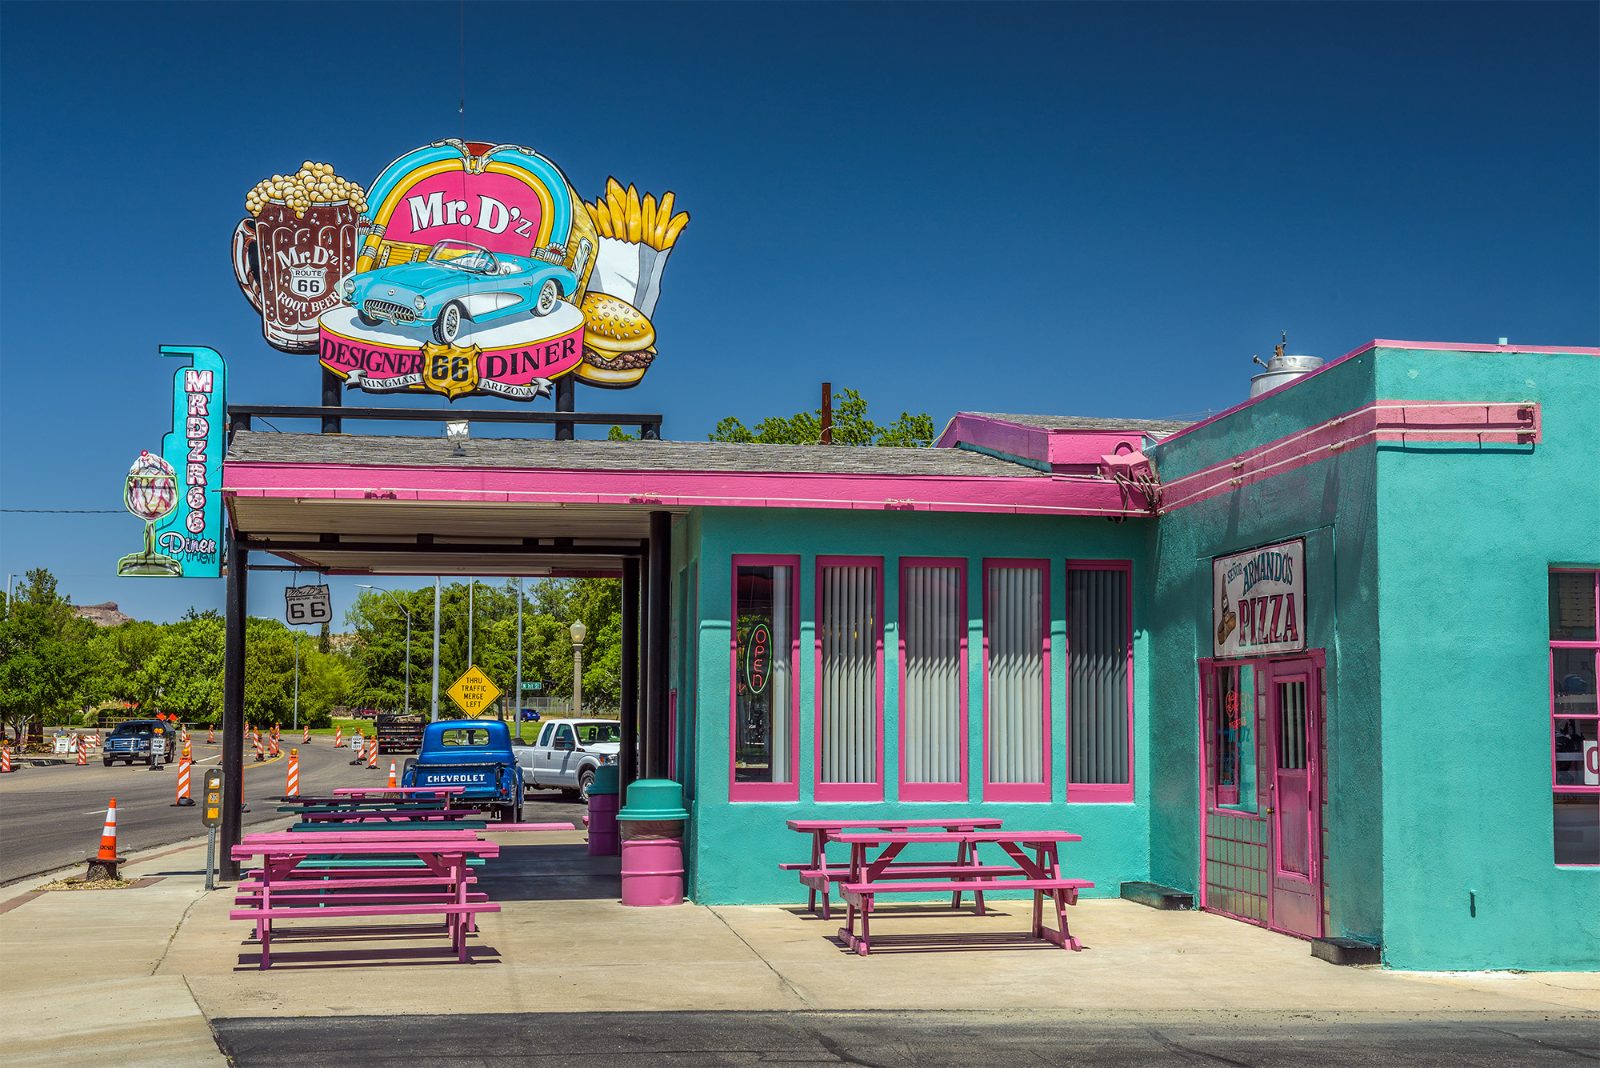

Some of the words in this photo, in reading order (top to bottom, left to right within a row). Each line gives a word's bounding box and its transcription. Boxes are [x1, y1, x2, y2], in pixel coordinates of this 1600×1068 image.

[406, 191, 472, 234] Mr.
[473, 194, 534, 239] D'z
[276, 246, 311, 270] Mr.
[312, 245, 339, 266] D'z
[297, 279, 320, 293] 66
[277, 291, 309, 312] ROOT
[311, 290, 340, 312] BEER
[321, 337, 424, 374] DESIGNER
[431, 355, 469, 381] 66
[486, 337, 576, 379] DINER
[362, 374, 417, 388] KINGMAN
[483, 380, 534, 396] ARIZONA
[158, 531, 216, 554] Diner
[1242, 551, 1293, 596] ARMANDO'S
[290, 602, 326, 618] 66
[1238, 592, 1298, 647] PIZZA
[463, 692, 484, 700] MERGE
[427, 774, 486, 783] CHEVROLET
